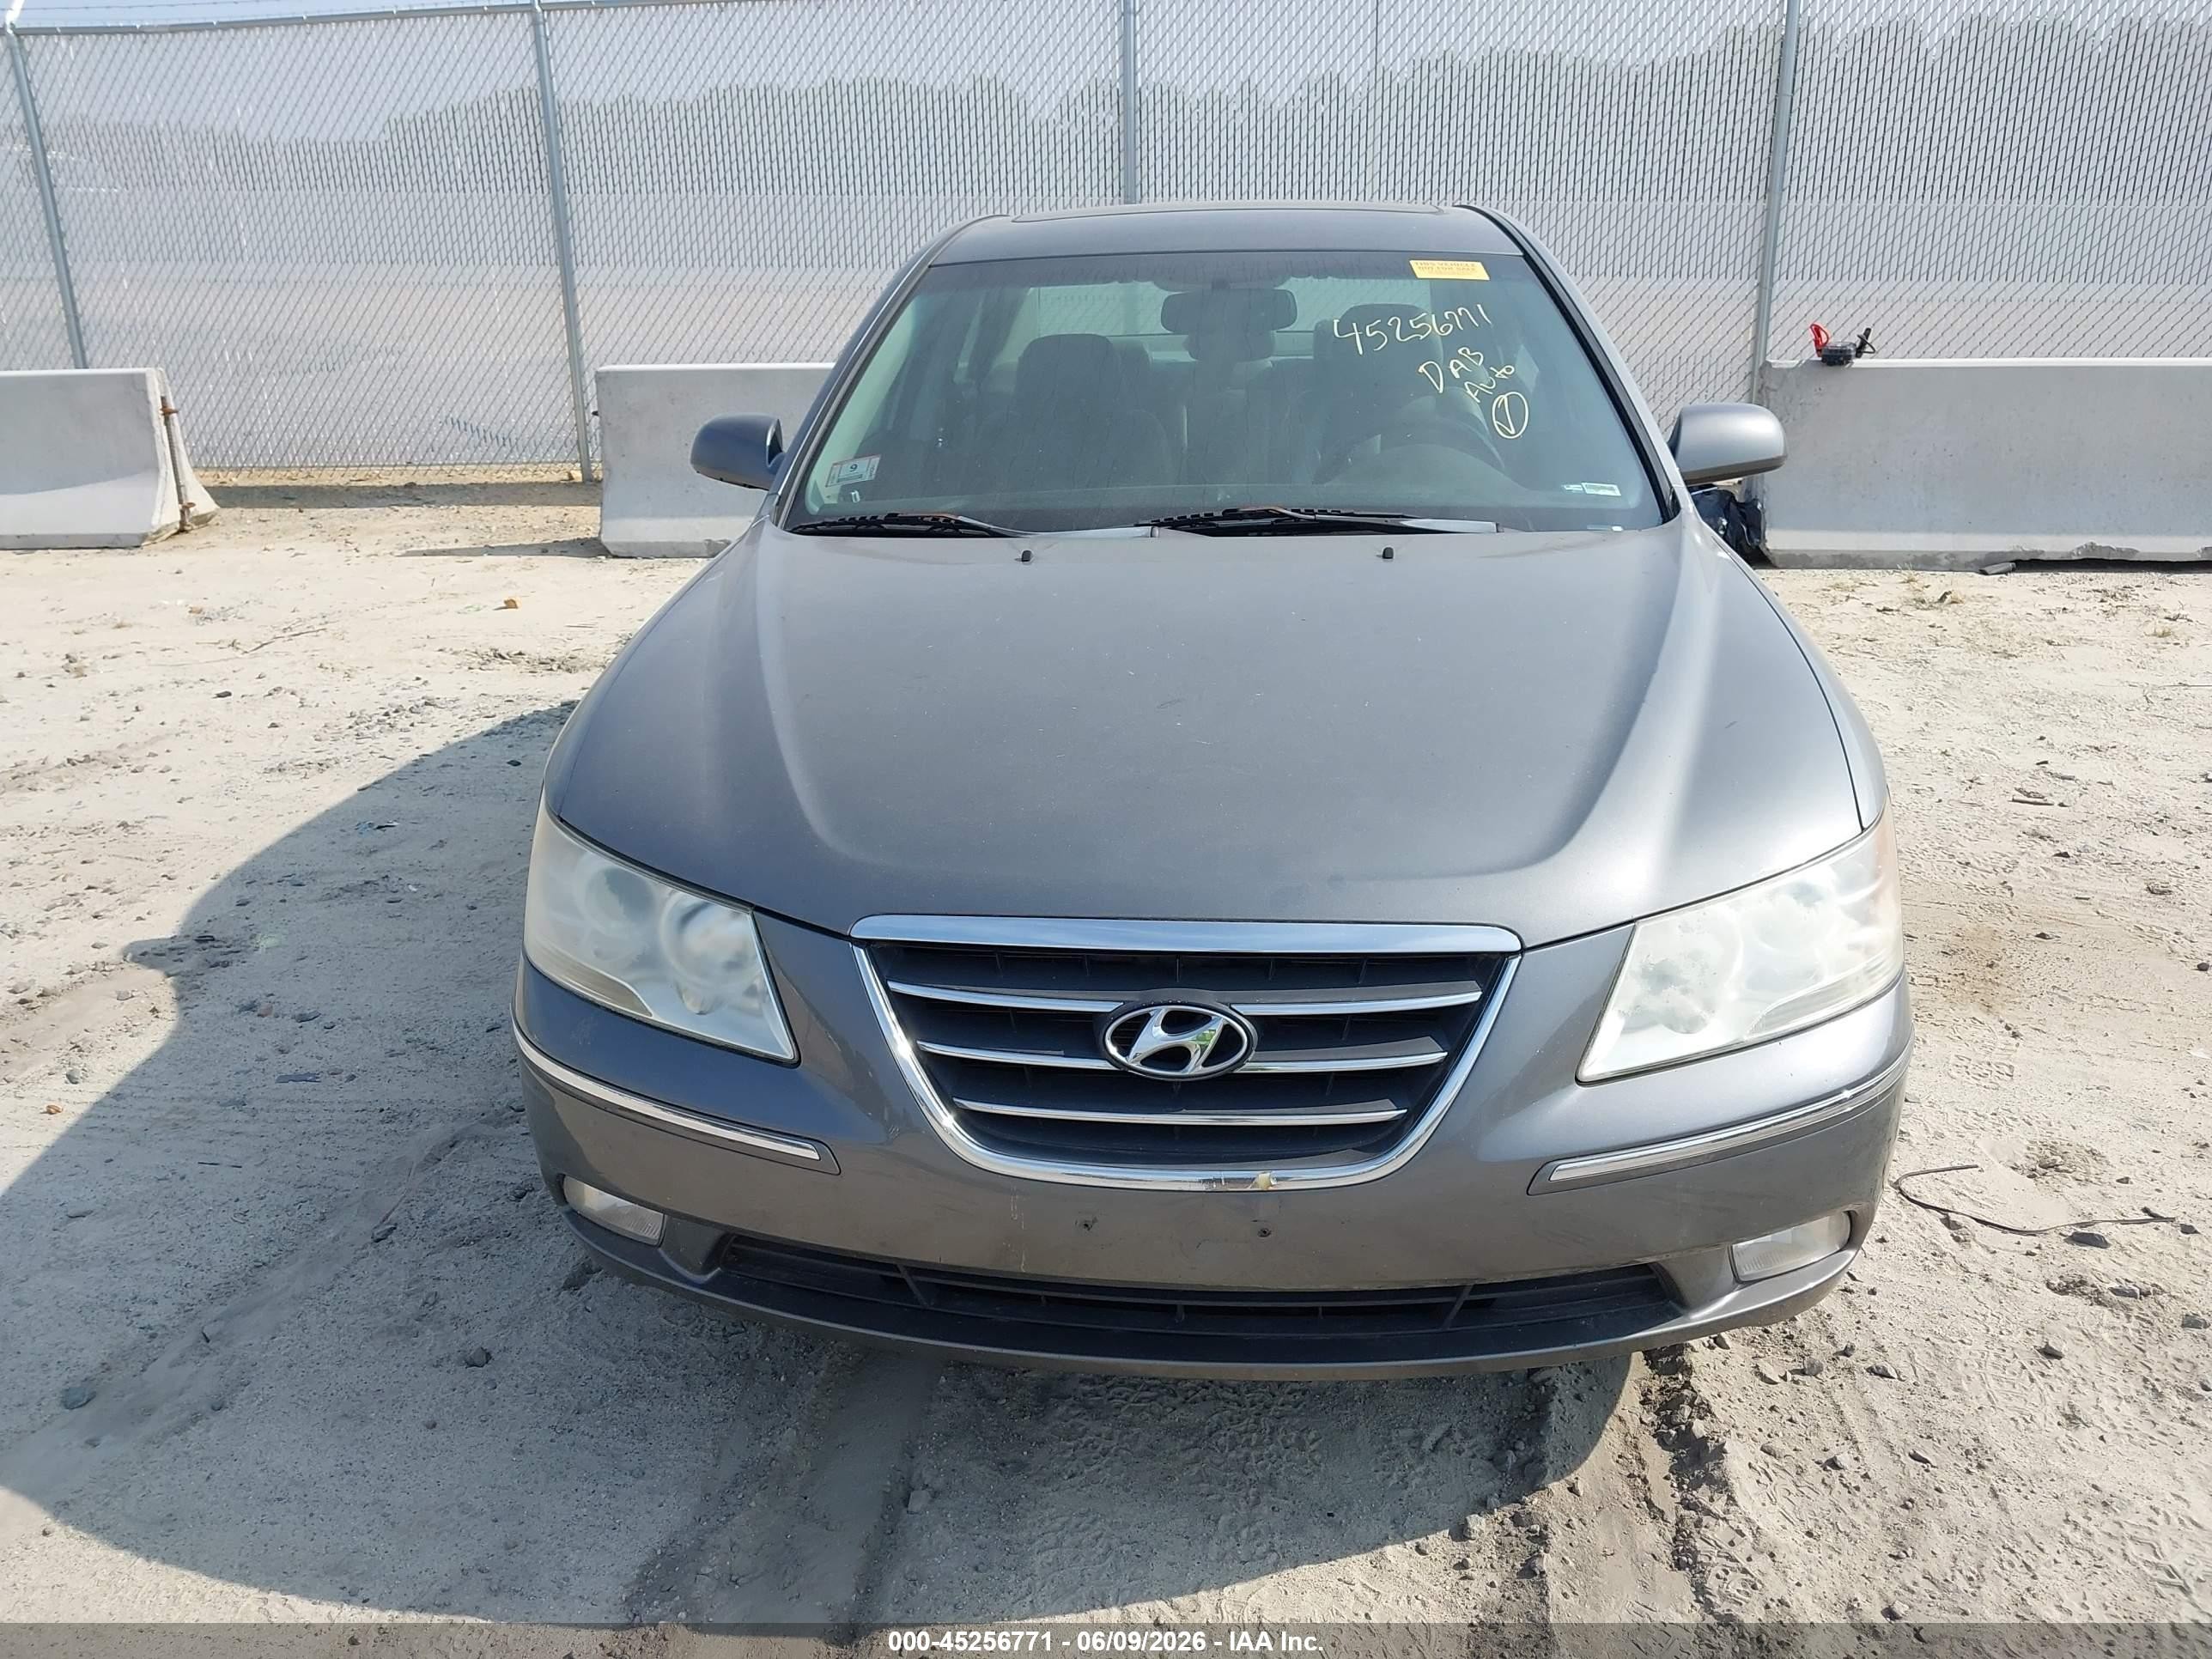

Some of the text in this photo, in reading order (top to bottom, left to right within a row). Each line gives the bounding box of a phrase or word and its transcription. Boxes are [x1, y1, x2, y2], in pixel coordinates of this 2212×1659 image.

[1333, 303, 1492, 356] 45256771
[1419, 346, 1484, 394] DAB
[849, 464, 858, 472] 9
